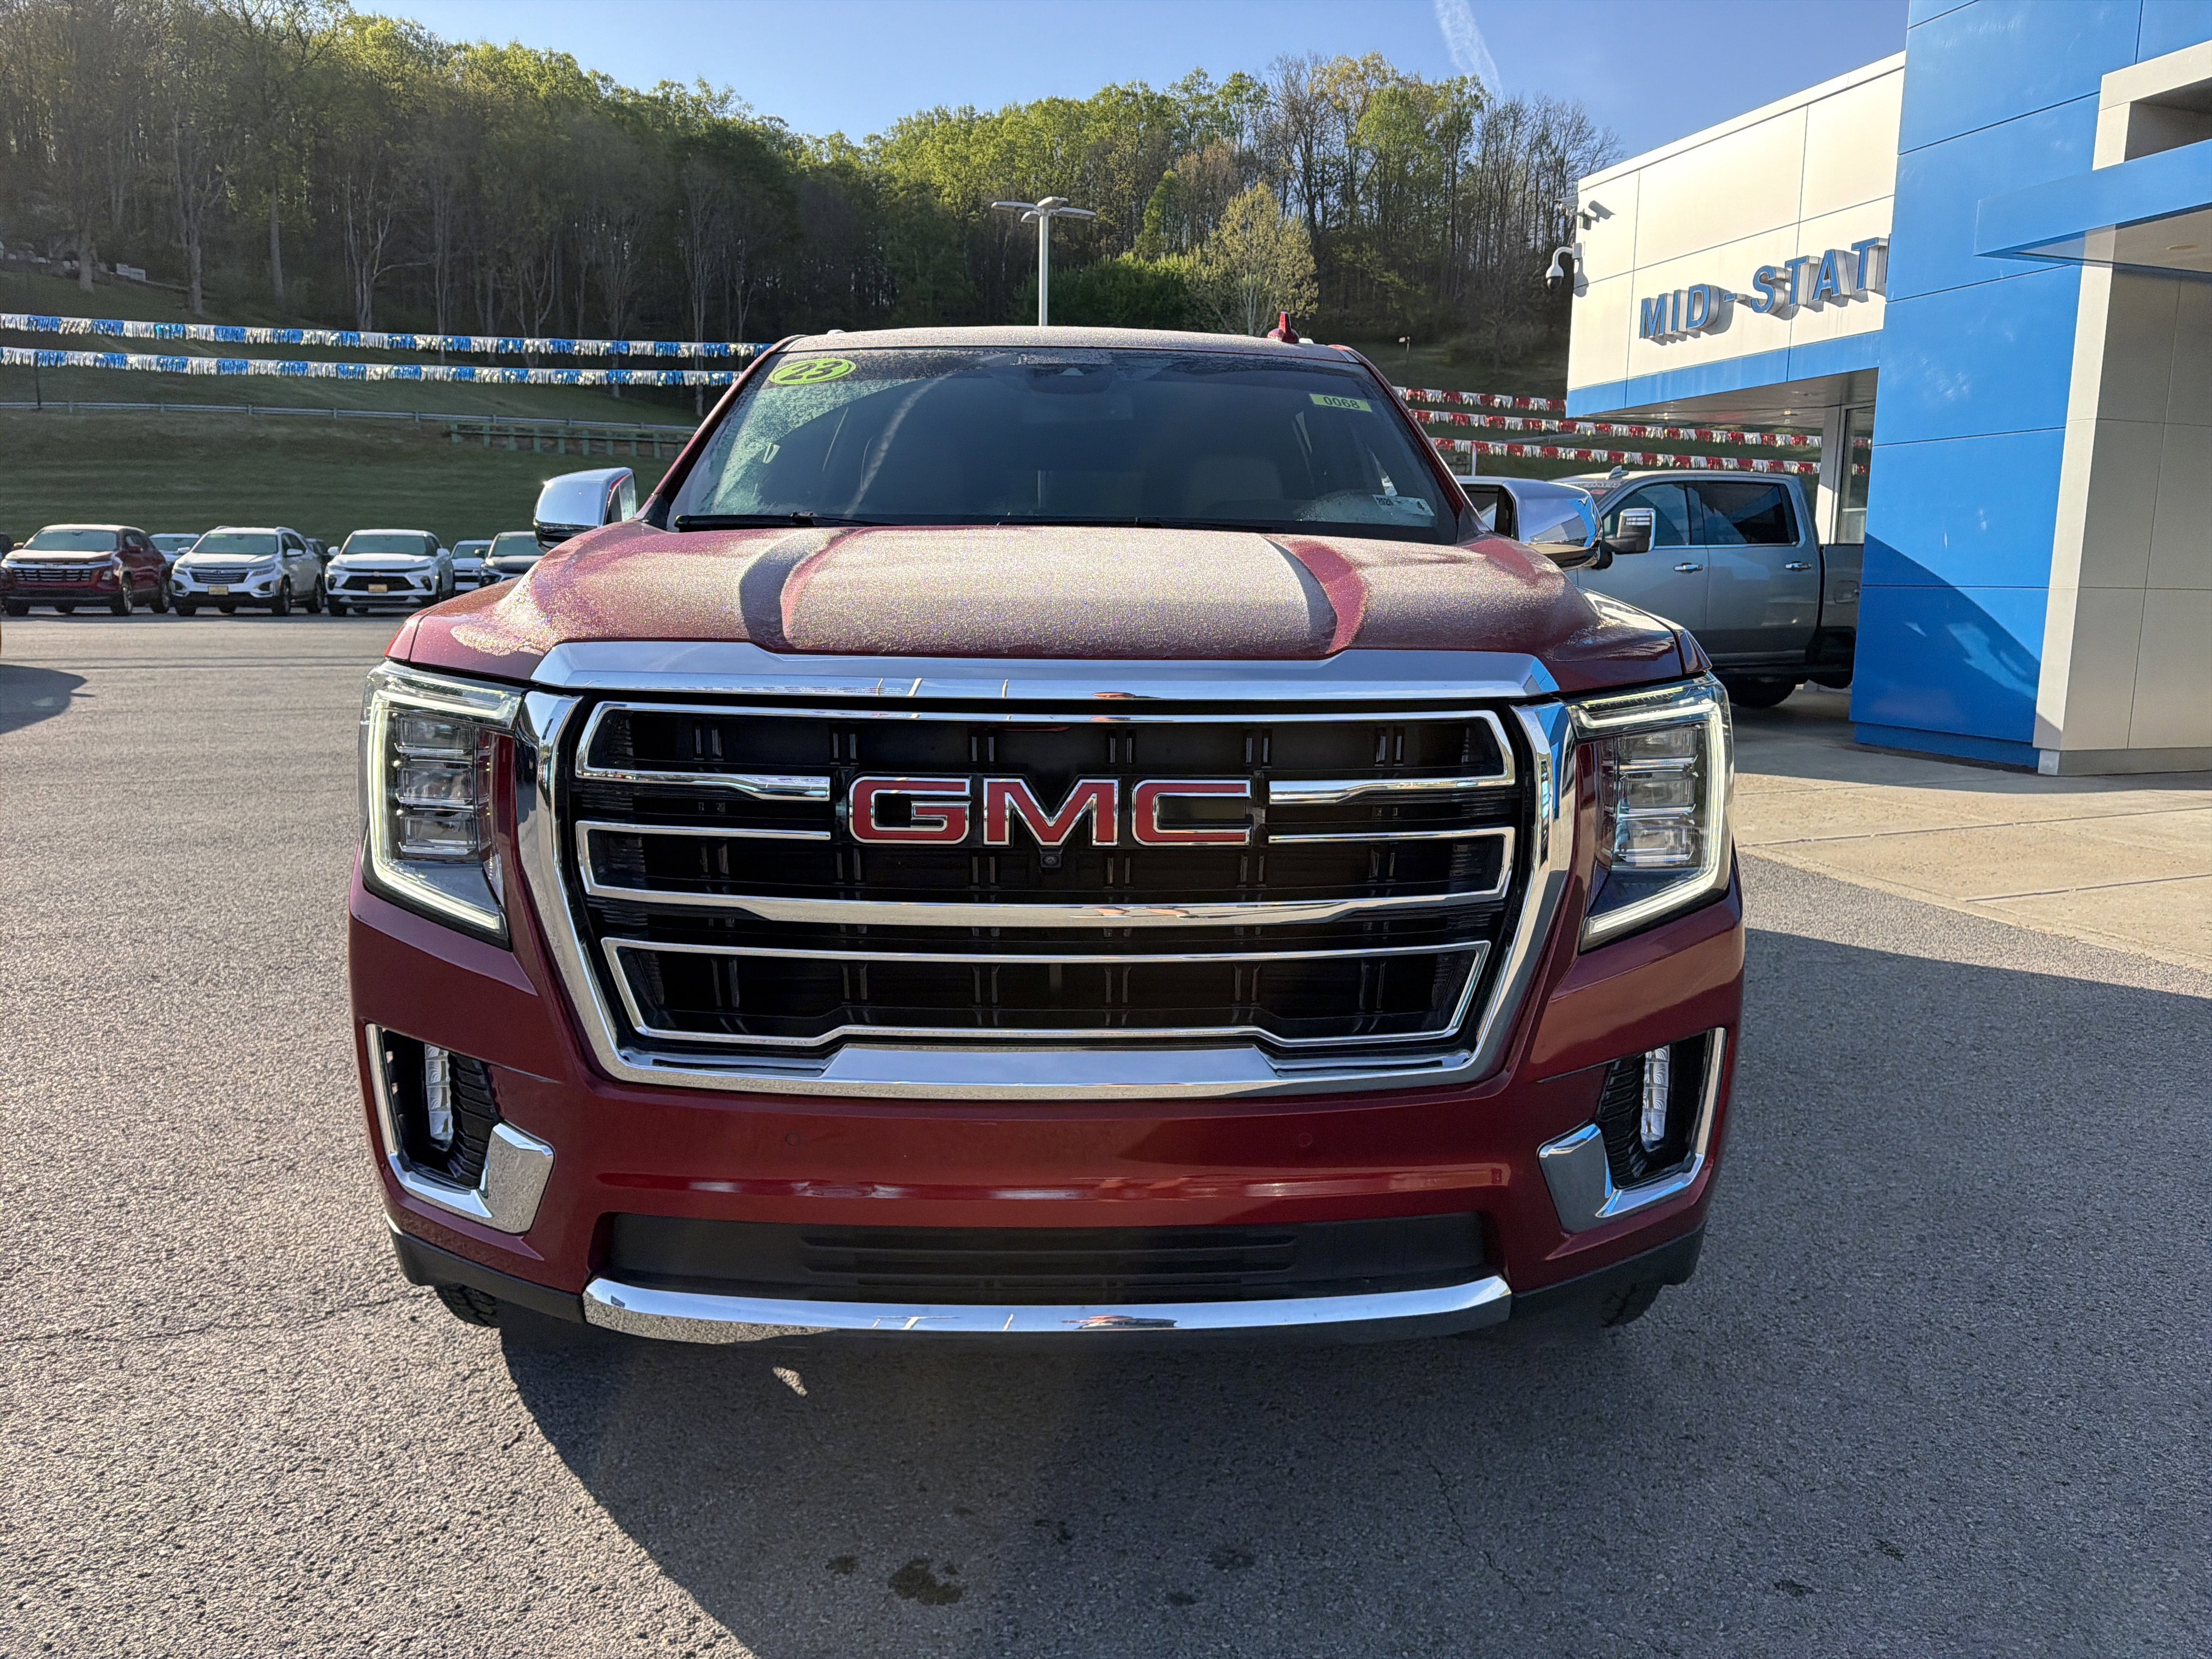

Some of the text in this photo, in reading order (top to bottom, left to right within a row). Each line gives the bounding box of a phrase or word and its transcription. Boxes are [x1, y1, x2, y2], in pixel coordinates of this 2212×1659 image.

[1639, 234, 1889, 338] MID-STAT
[780, 360, 843, 381] 23
[1323, 396, 1360, 409] 0068
[849, 776, 1252, 847] GMC
